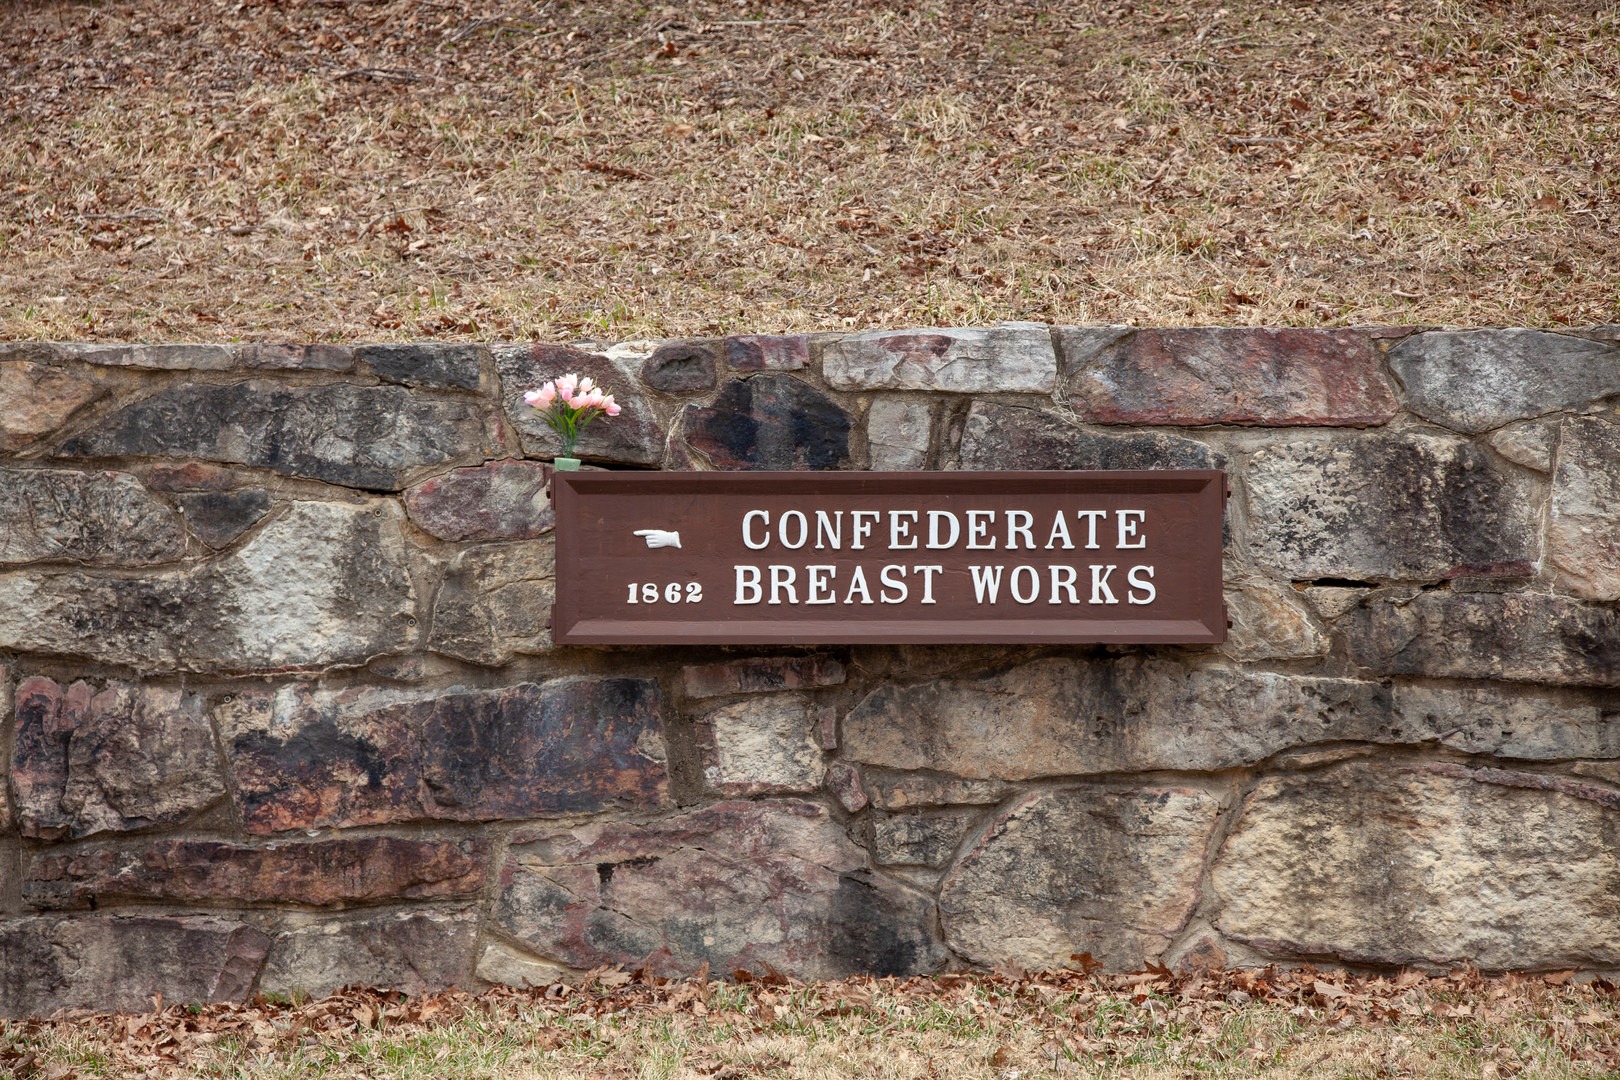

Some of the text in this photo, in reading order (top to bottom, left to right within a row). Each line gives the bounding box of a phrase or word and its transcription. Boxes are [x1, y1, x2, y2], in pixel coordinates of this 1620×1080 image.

[742, 509, 1147, 550] CONFEDERATE
[626, 581, 704, 604] 1862
[733, 564, 1156, 605] BREAST WORKS
